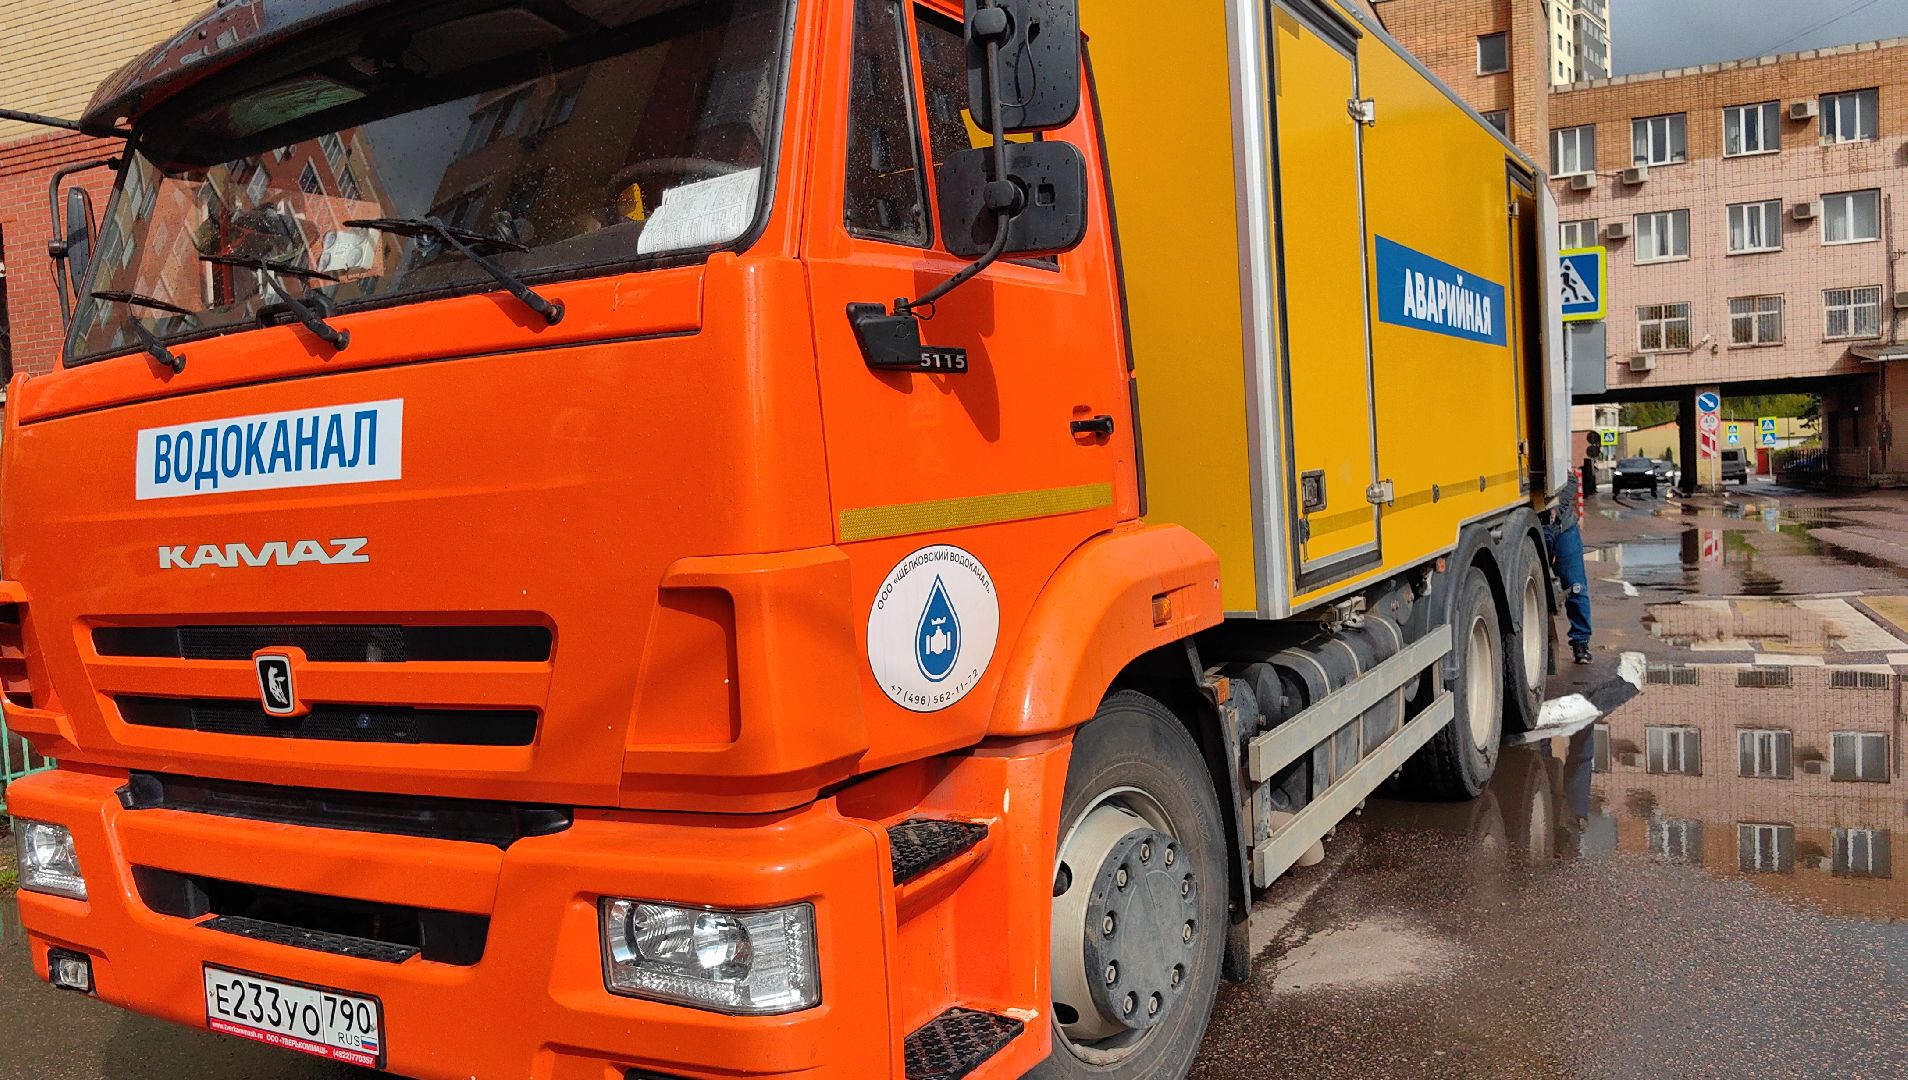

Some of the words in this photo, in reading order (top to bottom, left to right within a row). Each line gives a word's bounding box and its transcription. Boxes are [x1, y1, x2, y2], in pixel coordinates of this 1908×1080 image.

[1403, 267, 1492, 336] АВАРИЙНАЯ
[920, 353, 966, 369] 5115
[154, 409, 378, 491] ВОДОКАНАЛ
[158, 537, 369, 569] KAMAZ
[877, 583, 894, 610] ООО
[890, 684, 903, 696] +7
[903, 690, 931, 707] (496)
[933, 668, 979, 704] 562-11-72
[338, 1031, 361, 1048] RUS
